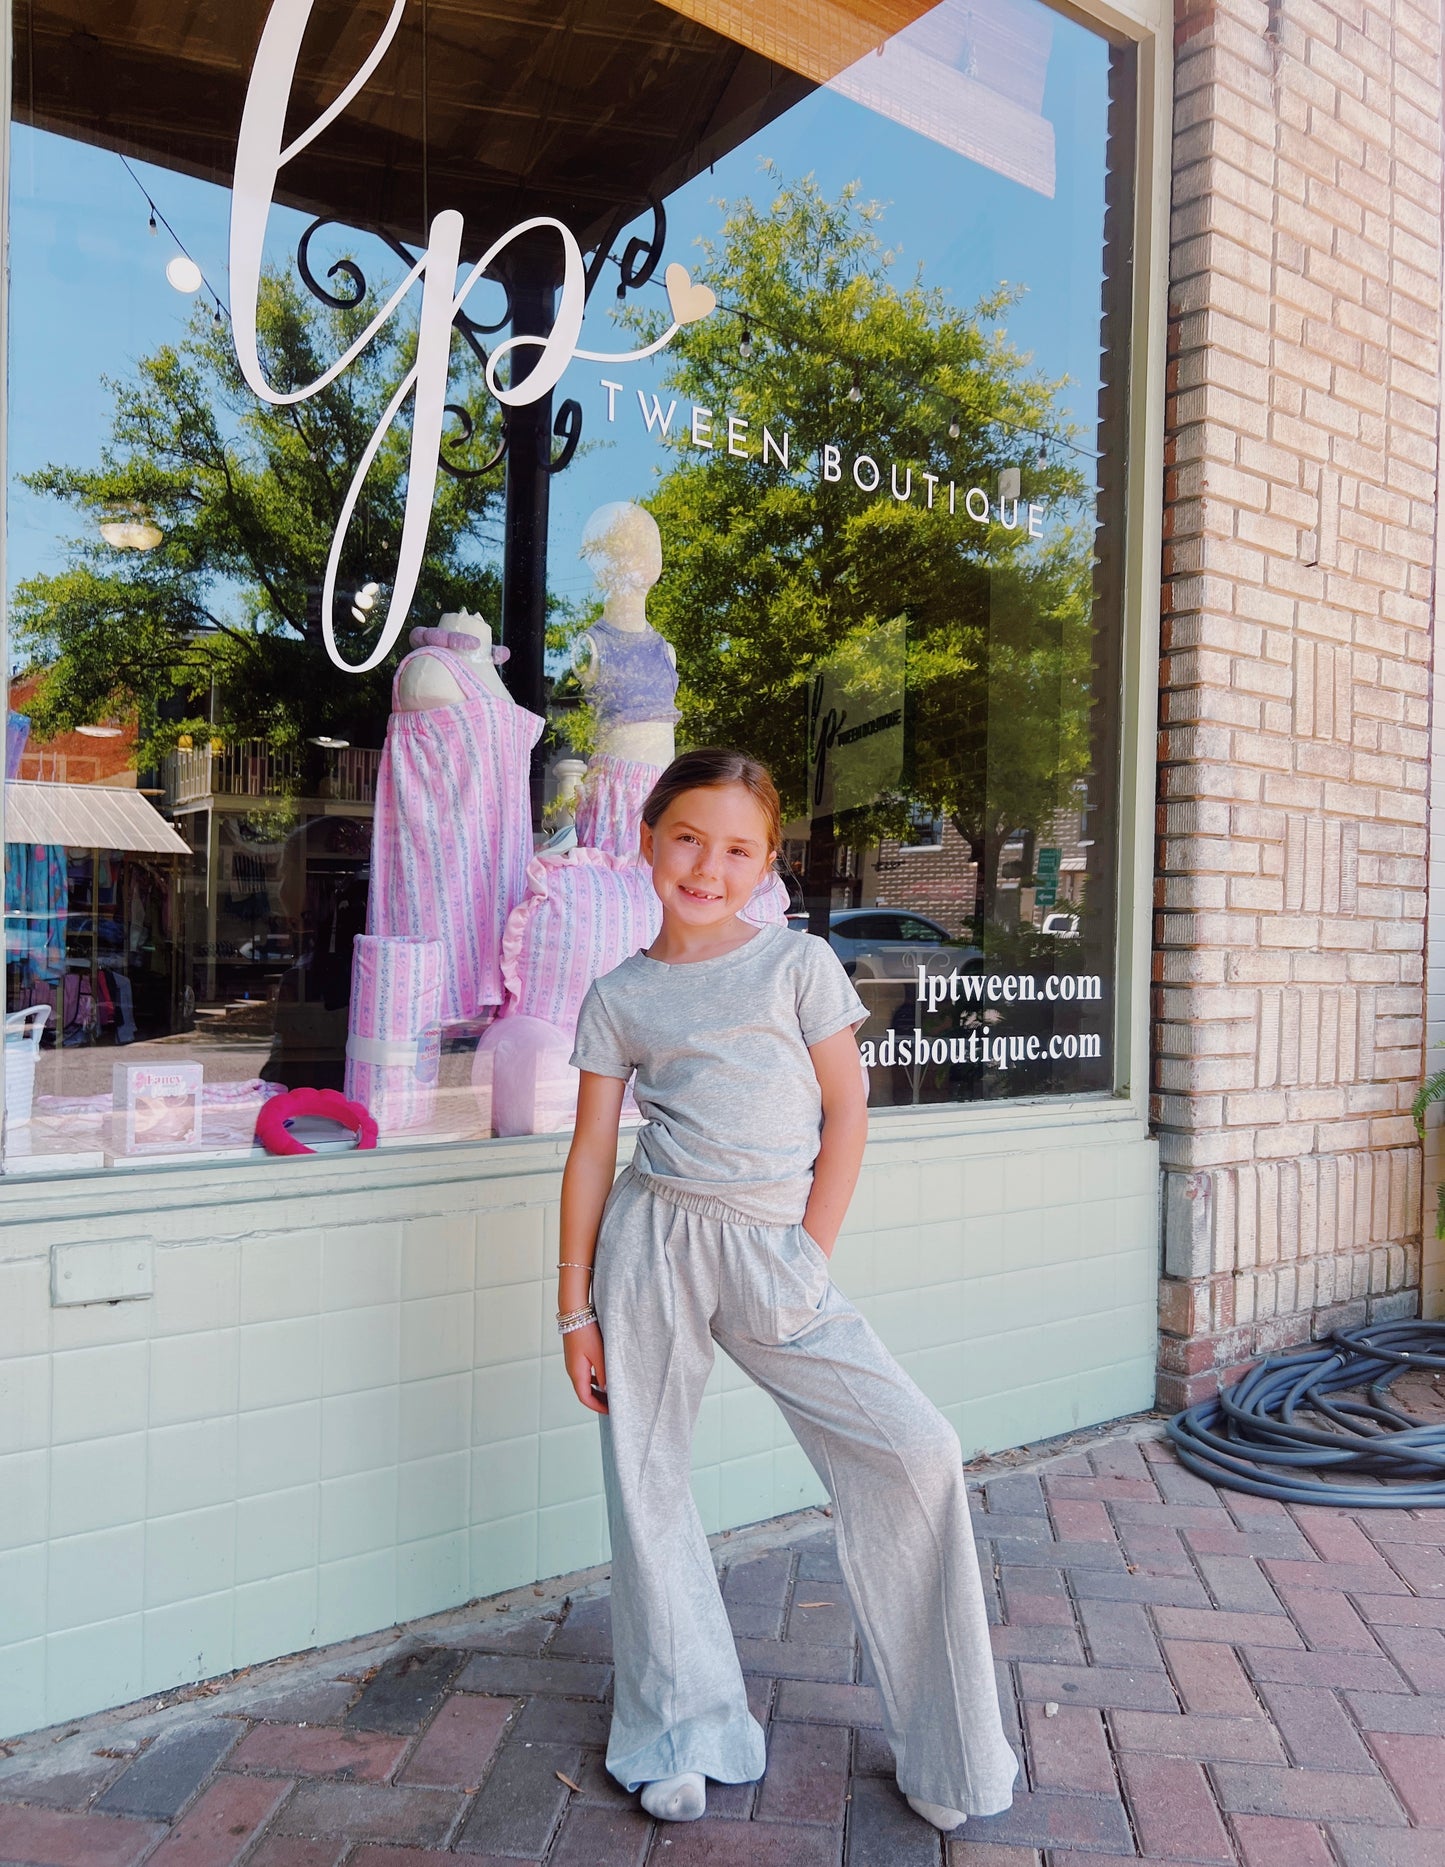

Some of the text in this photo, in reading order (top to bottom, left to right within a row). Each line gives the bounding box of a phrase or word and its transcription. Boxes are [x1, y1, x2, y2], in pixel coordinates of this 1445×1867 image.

[600, 379, 1044, 539] TWEEN BOUTIQUE
[916, 964, 1102, 1013] lptween.com
